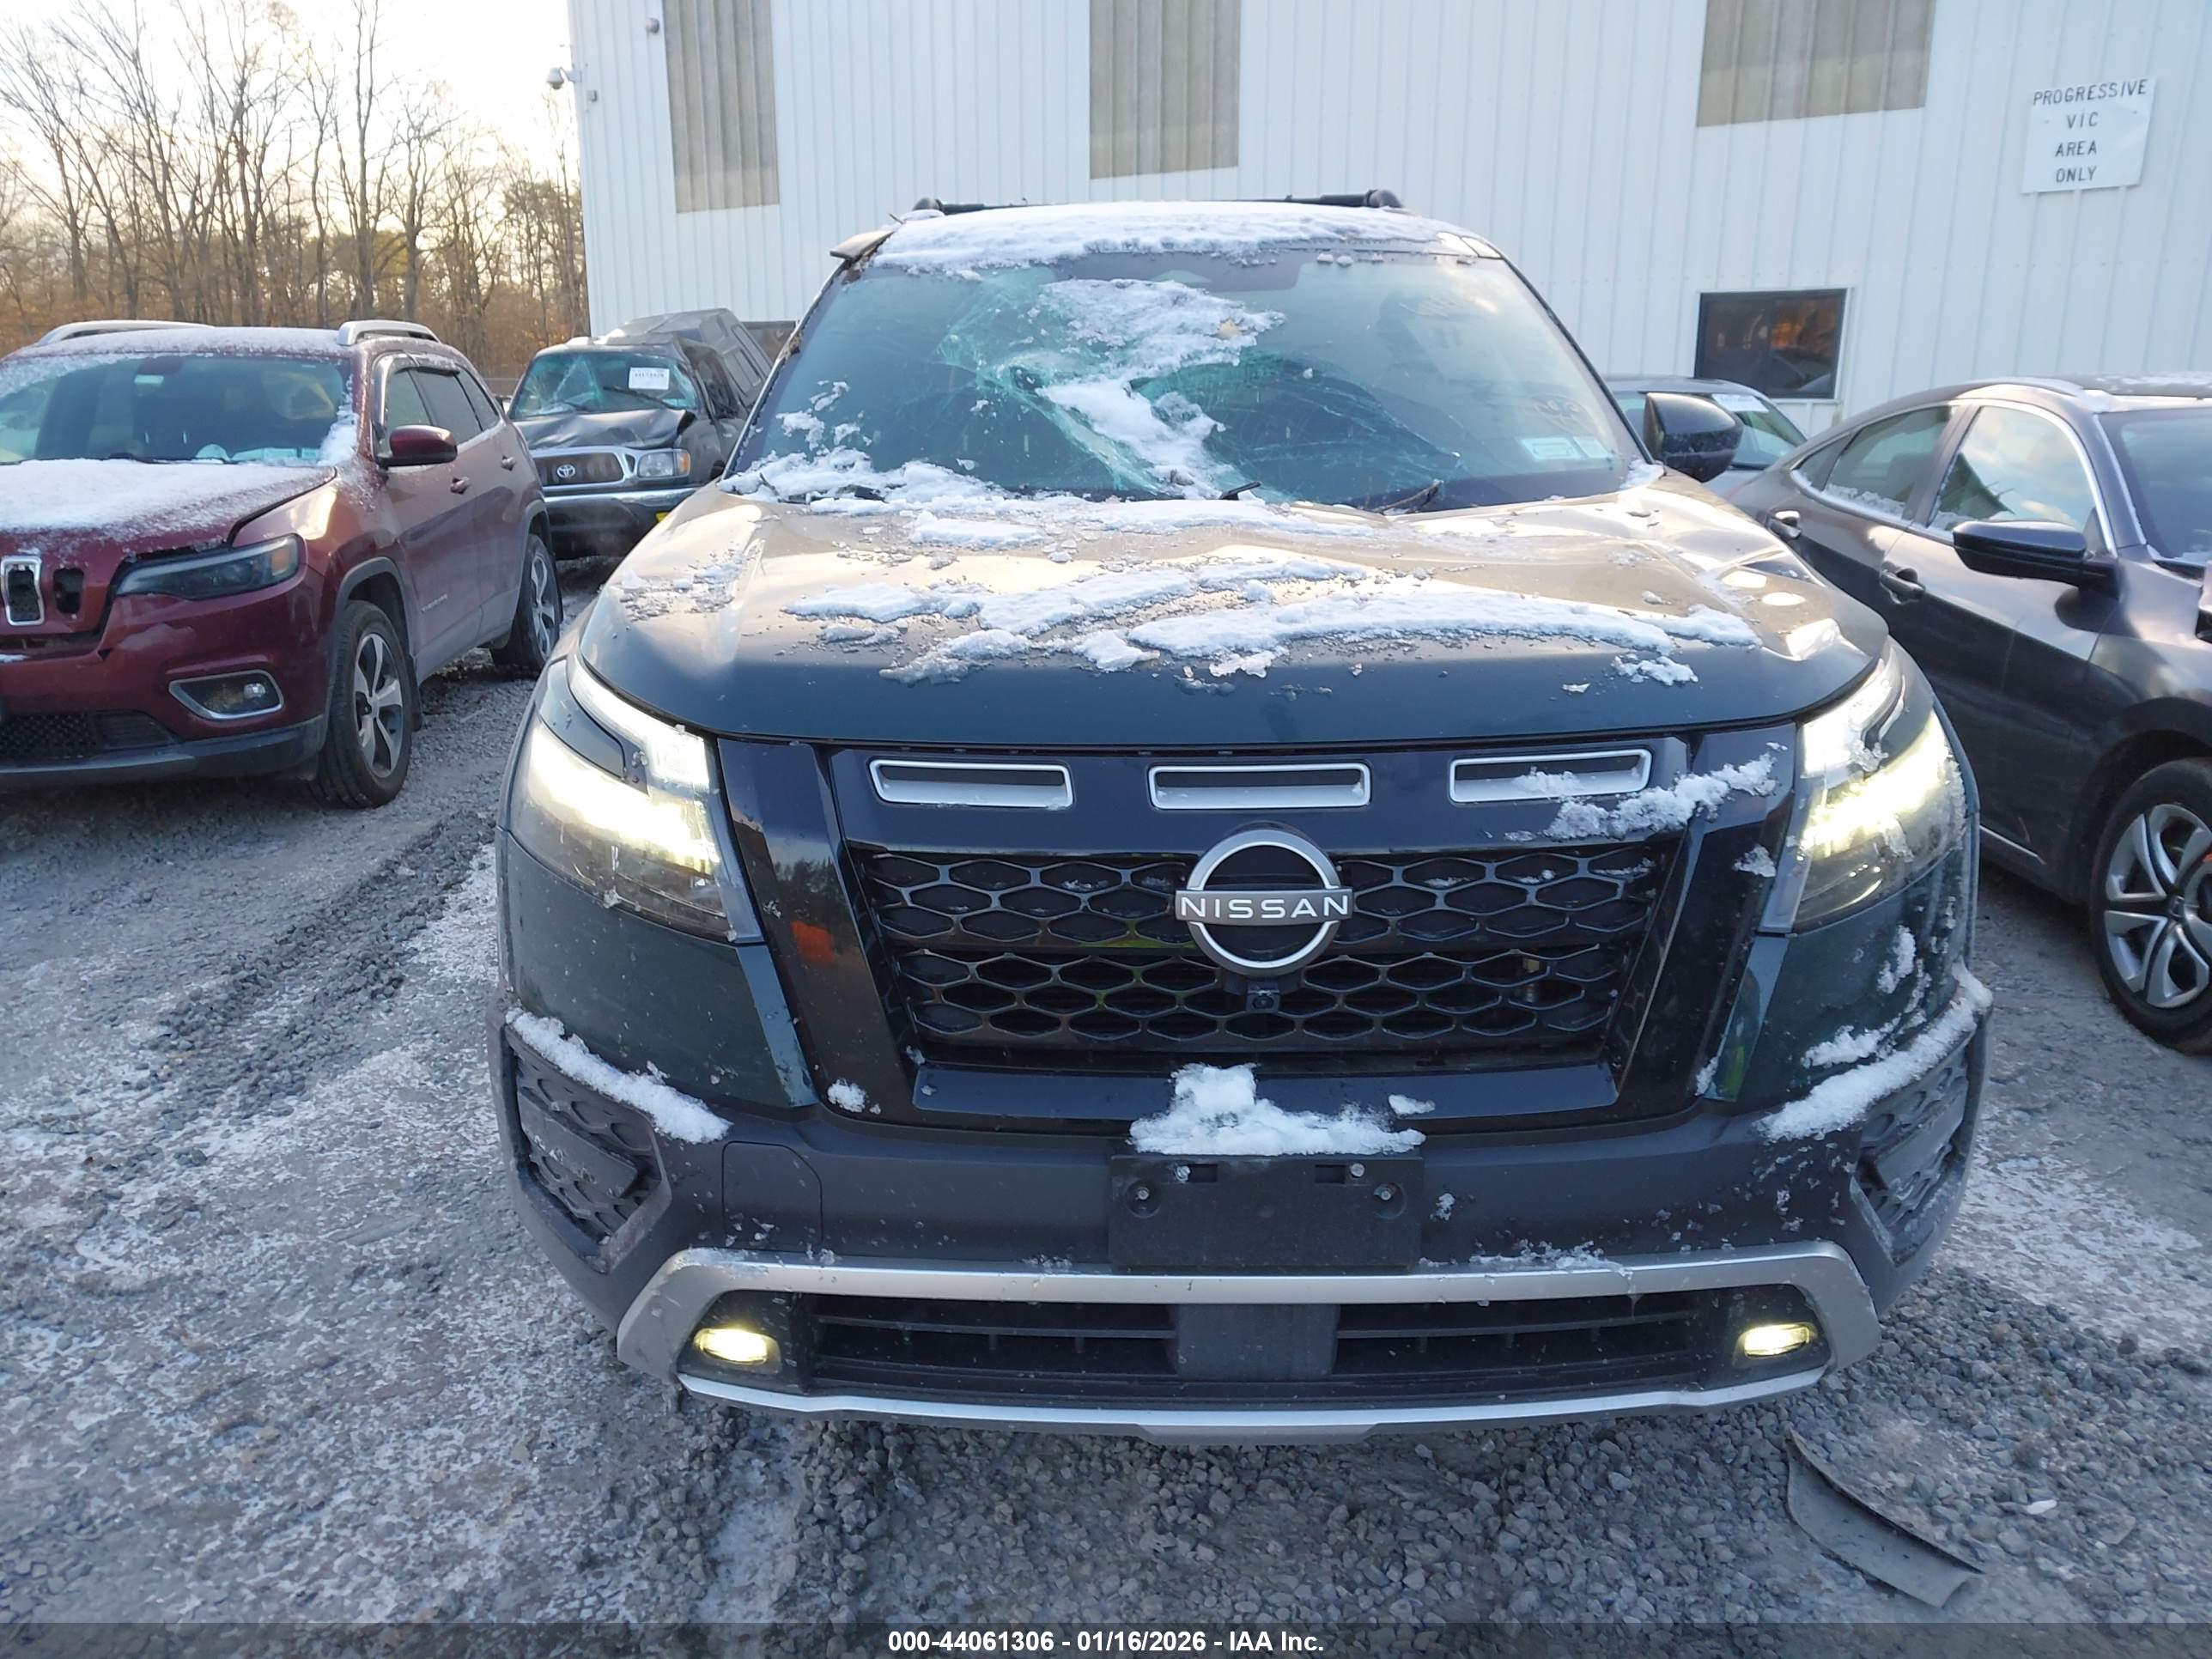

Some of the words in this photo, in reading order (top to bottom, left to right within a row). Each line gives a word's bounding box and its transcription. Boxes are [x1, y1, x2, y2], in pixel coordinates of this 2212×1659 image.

[2033, 79, 2148, 106] PROGRESSIVE
[2066, 112, 2099, 130] VIC
[2055, 139, 2098, 158] AREA
[2055, 166, 2098, 184] ONLY
[1181, 895, 1349, 919] NISSAN
